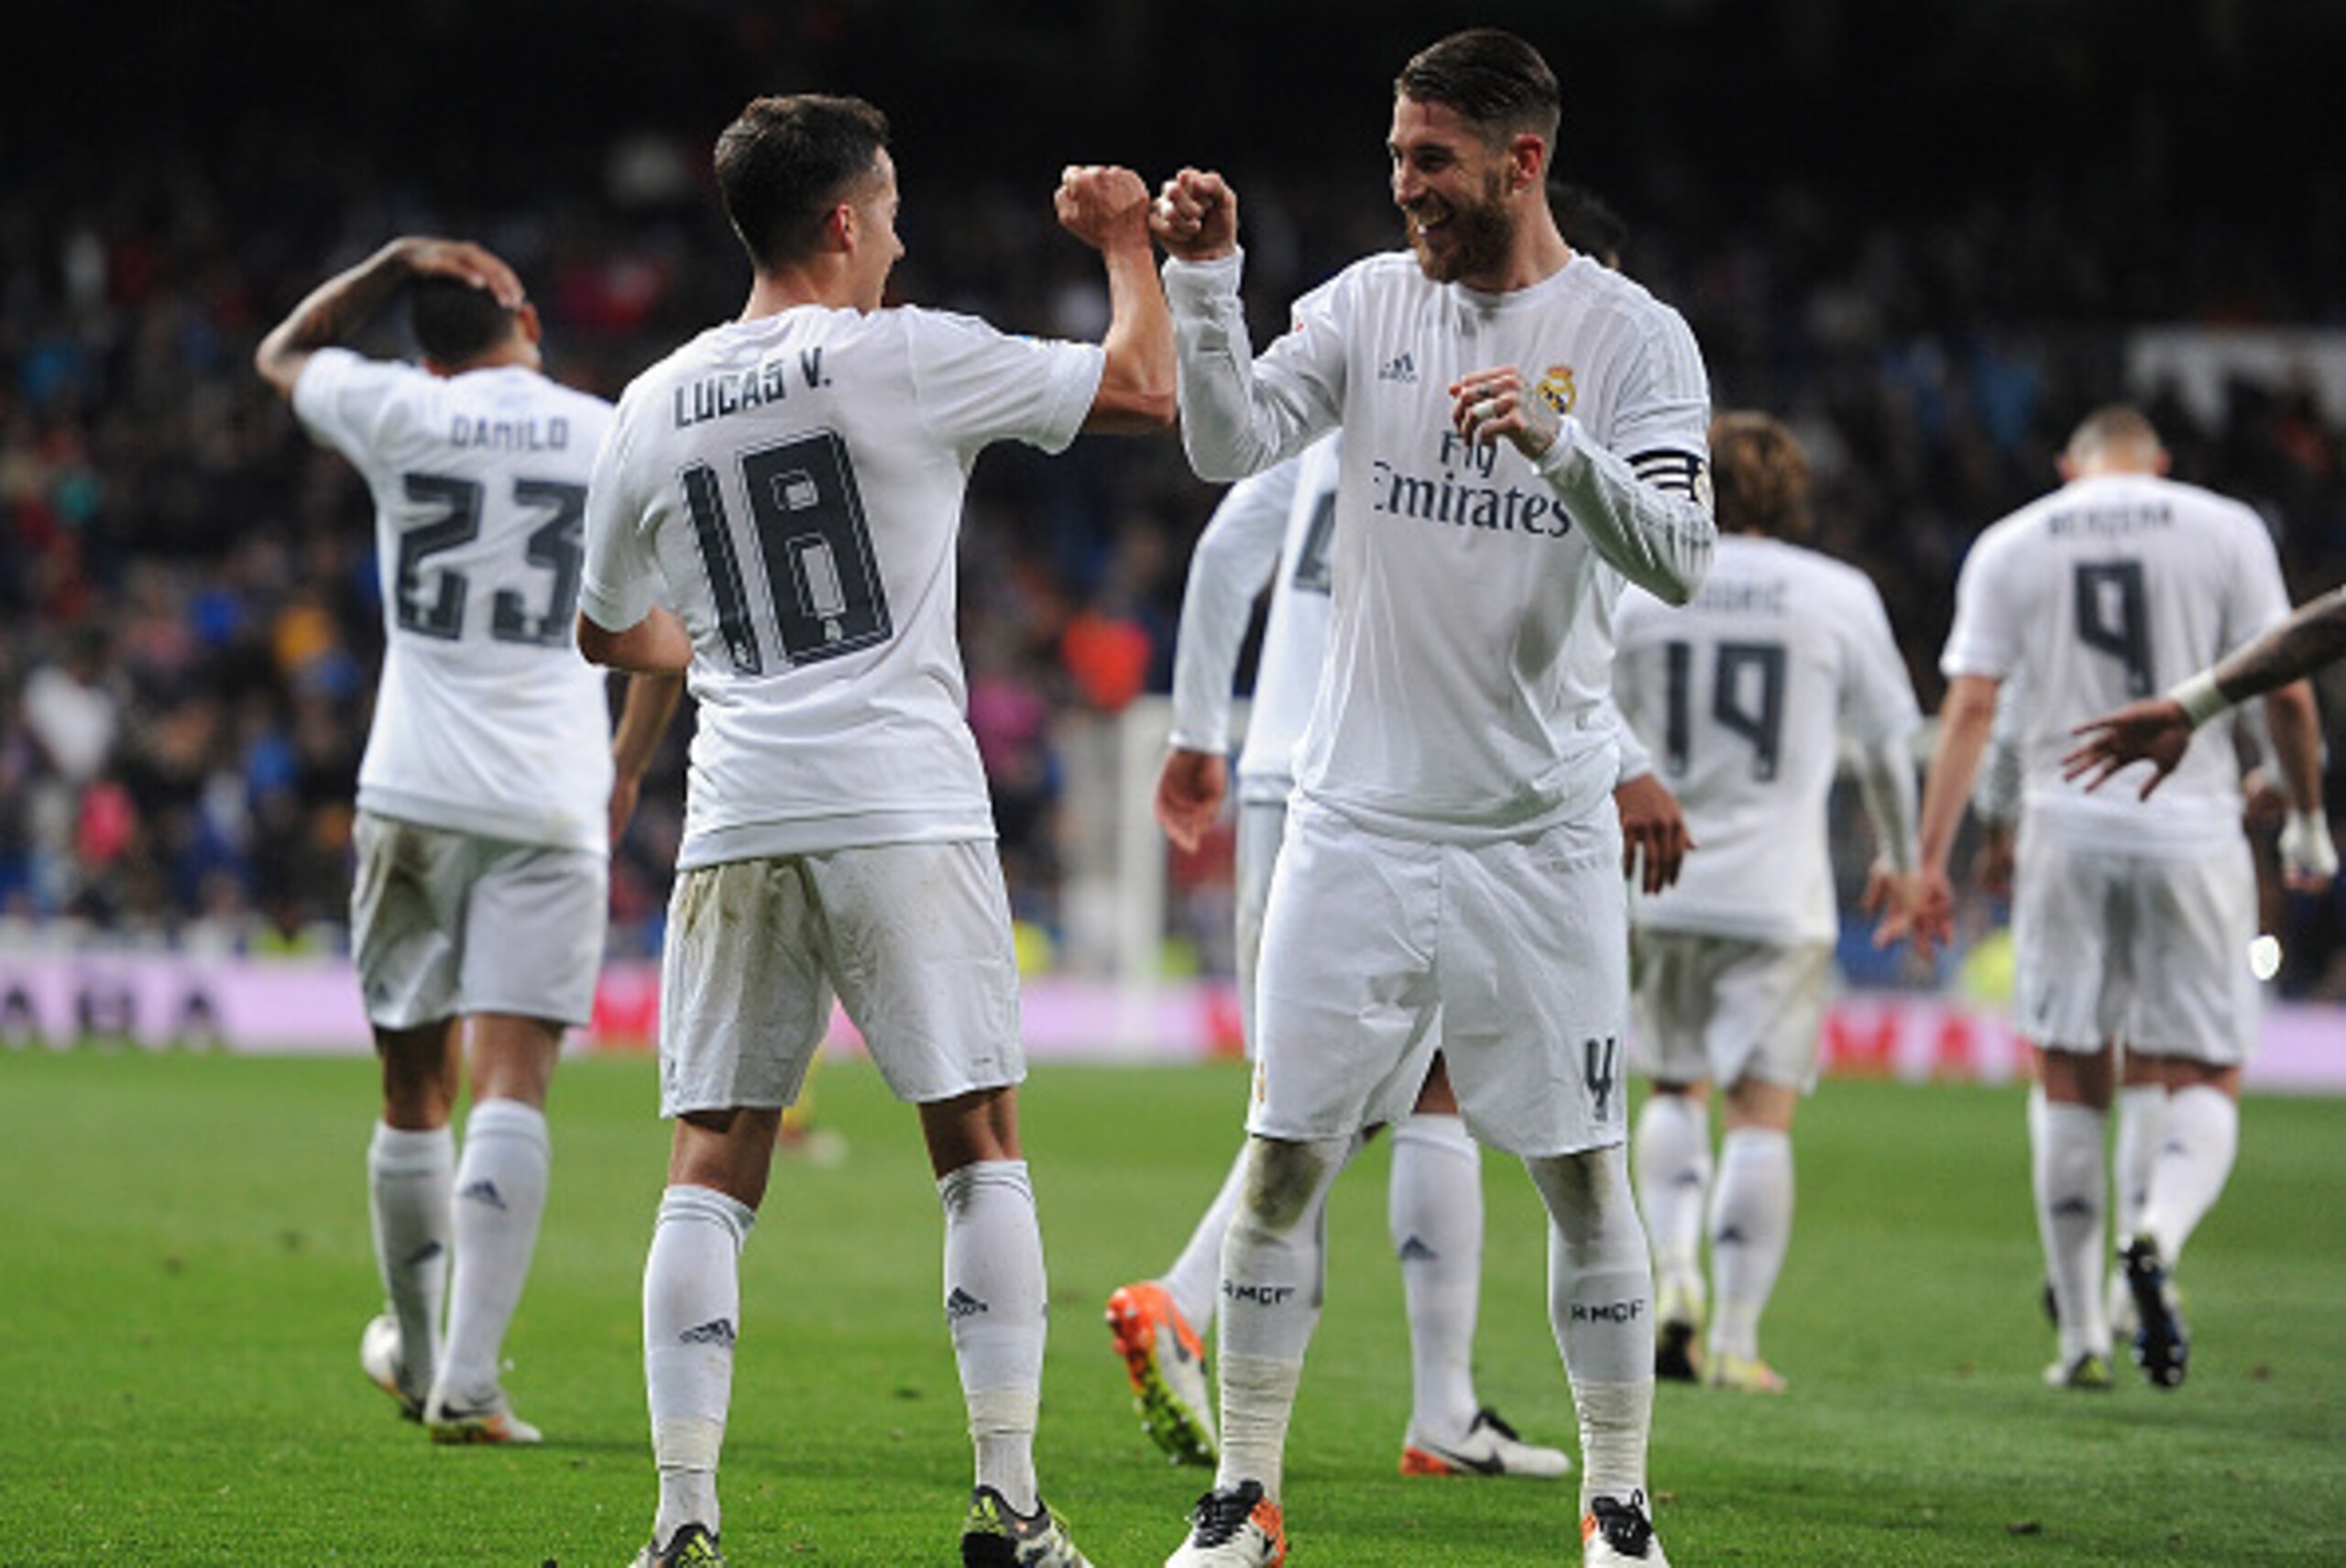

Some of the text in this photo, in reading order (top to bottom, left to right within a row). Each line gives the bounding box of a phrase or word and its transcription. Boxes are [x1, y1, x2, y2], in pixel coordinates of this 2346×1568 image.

[674, 345, 832, 429] LUCAS V.
[450, 417, 569, 450] DANILO
[1439, 429, 1497, 478] Fly
[1373, 460, 1572, 538] Emirates
[395, 472, 589, 648] 23
[676, 426, 893, 675] 18
[2073, 561, 2156, 703] 9
[1665, 640, 1788, 784] 19
[1584, 1037, 1615, 1123] 4
[1571, 1298, 1645, 1324] RMCF
